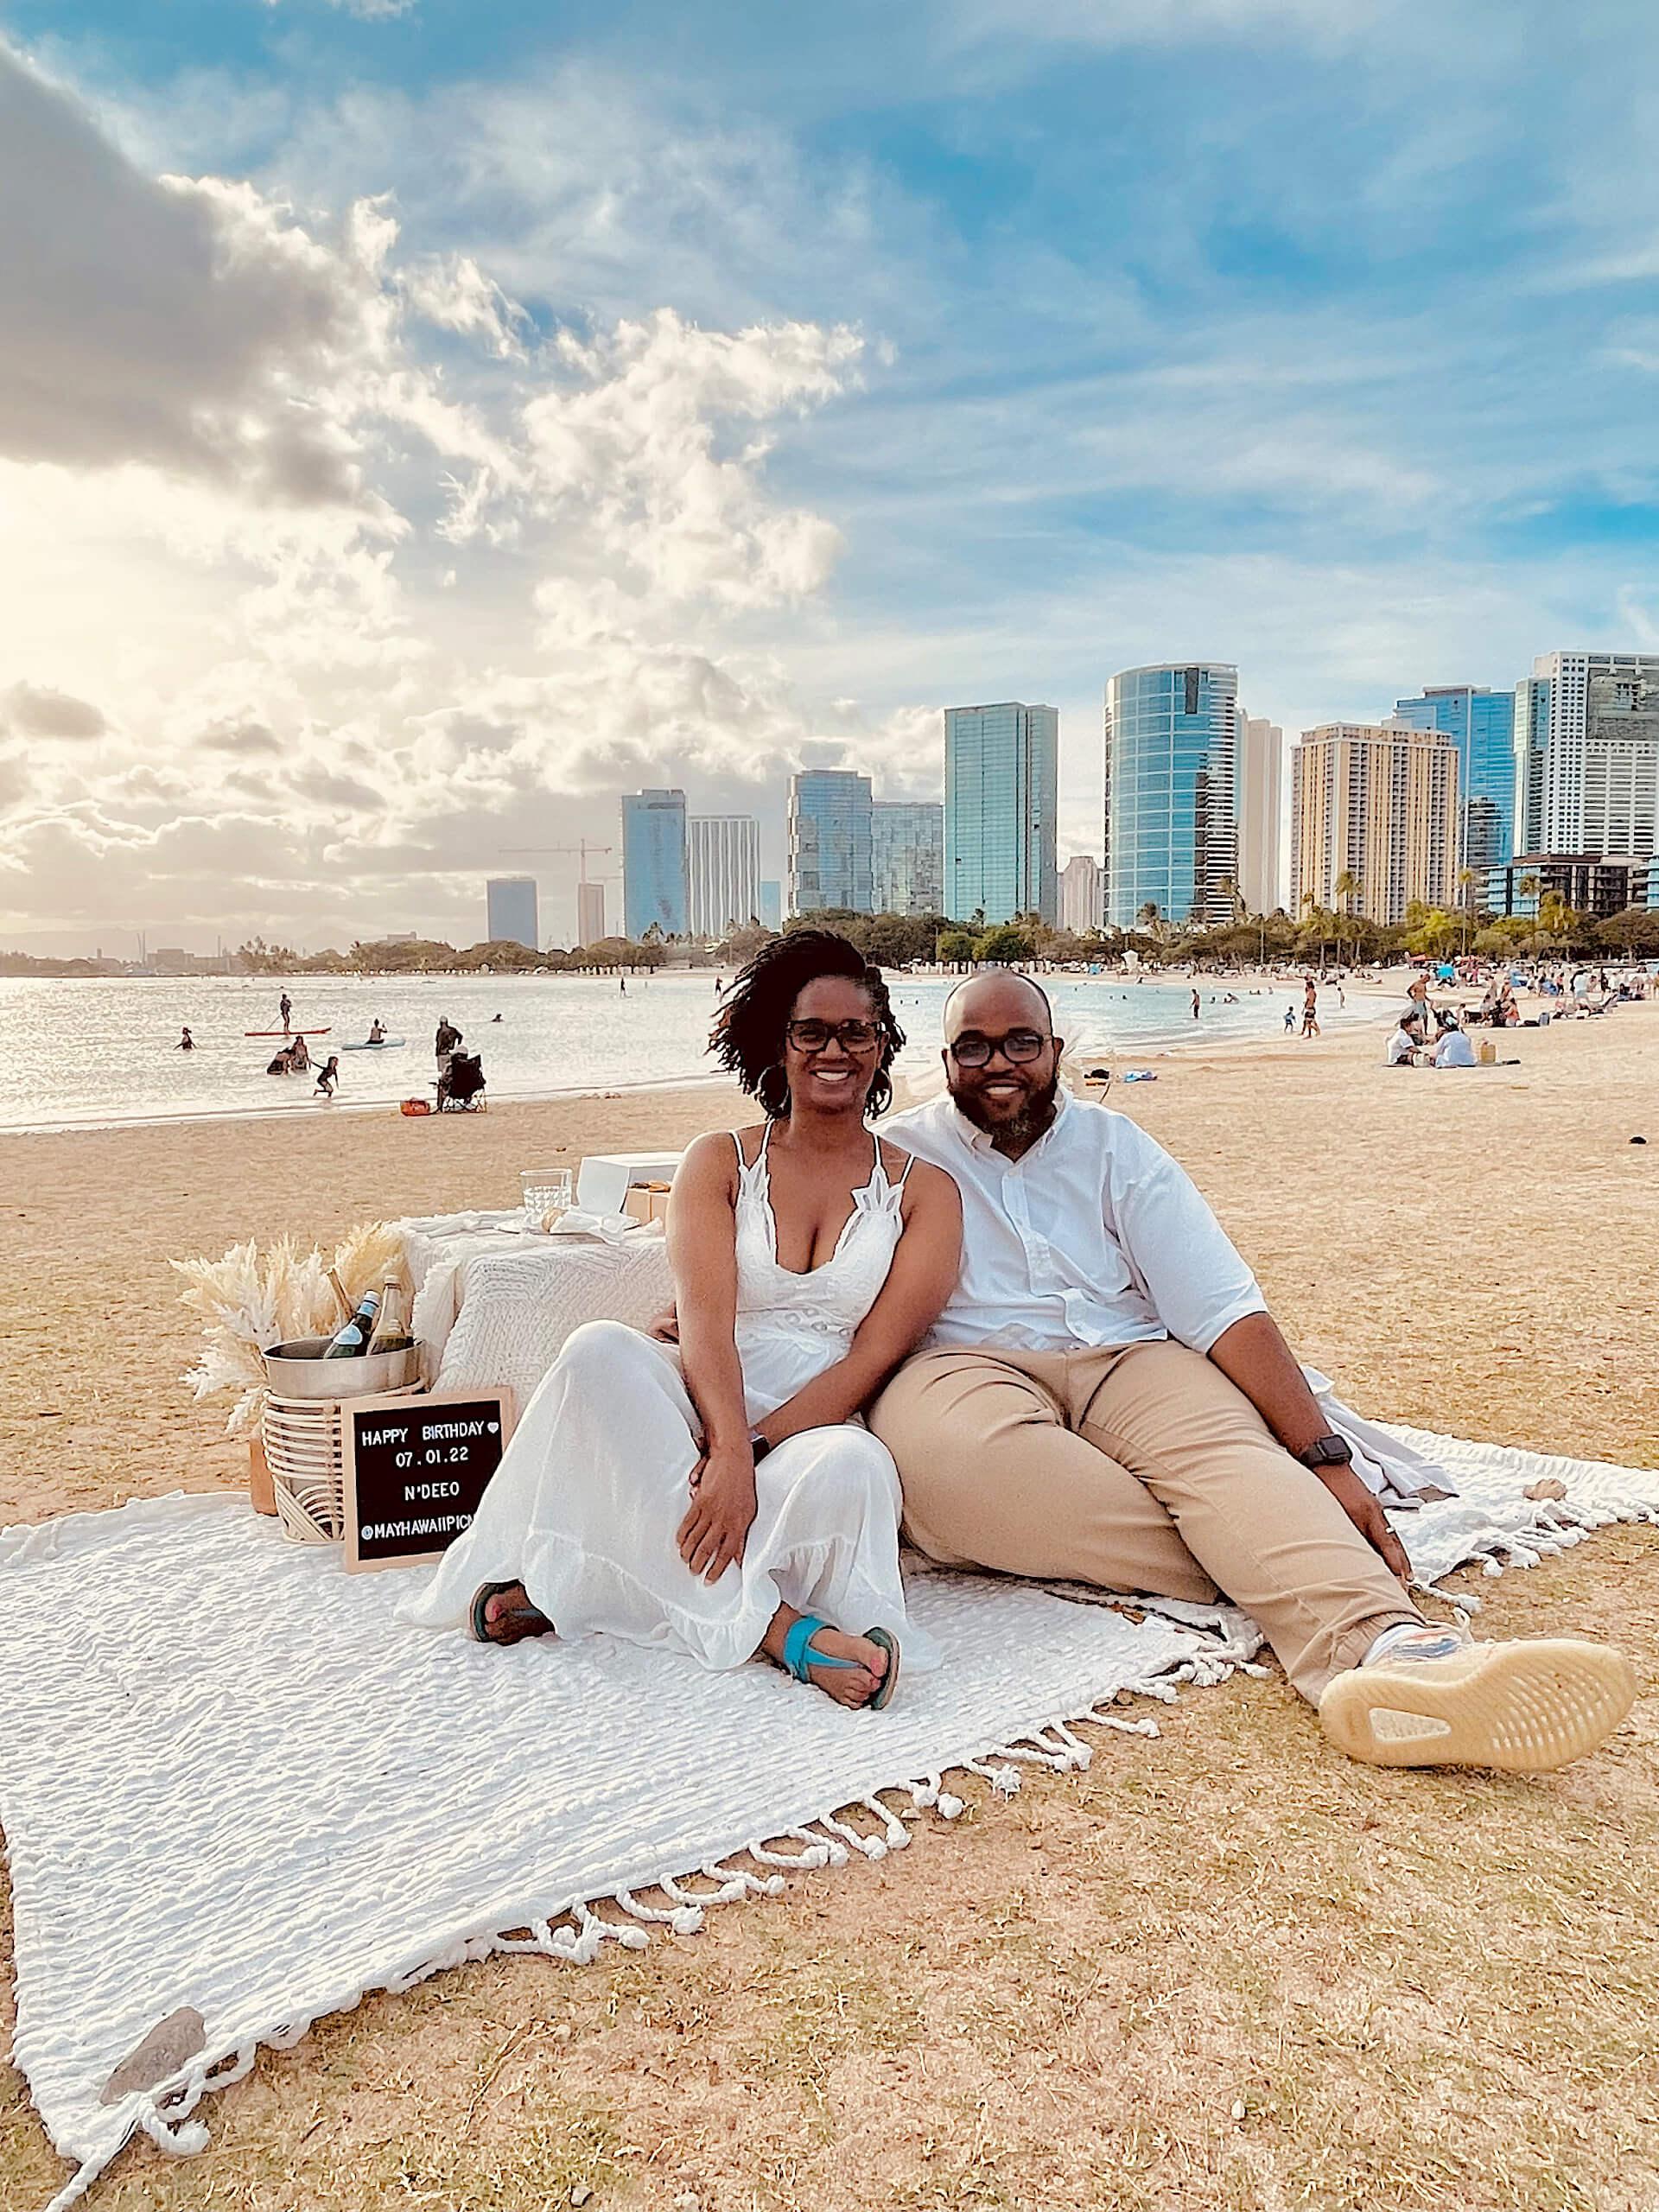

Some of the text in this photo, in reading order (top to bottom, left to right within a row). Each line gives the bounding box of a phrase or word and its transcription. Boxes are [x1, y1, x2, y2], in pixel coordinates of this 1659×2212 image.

[362, 1421, 484, 1446] HAPPY BIRTHDAY
[404, 1481, 460, 1501] N'DEEO
